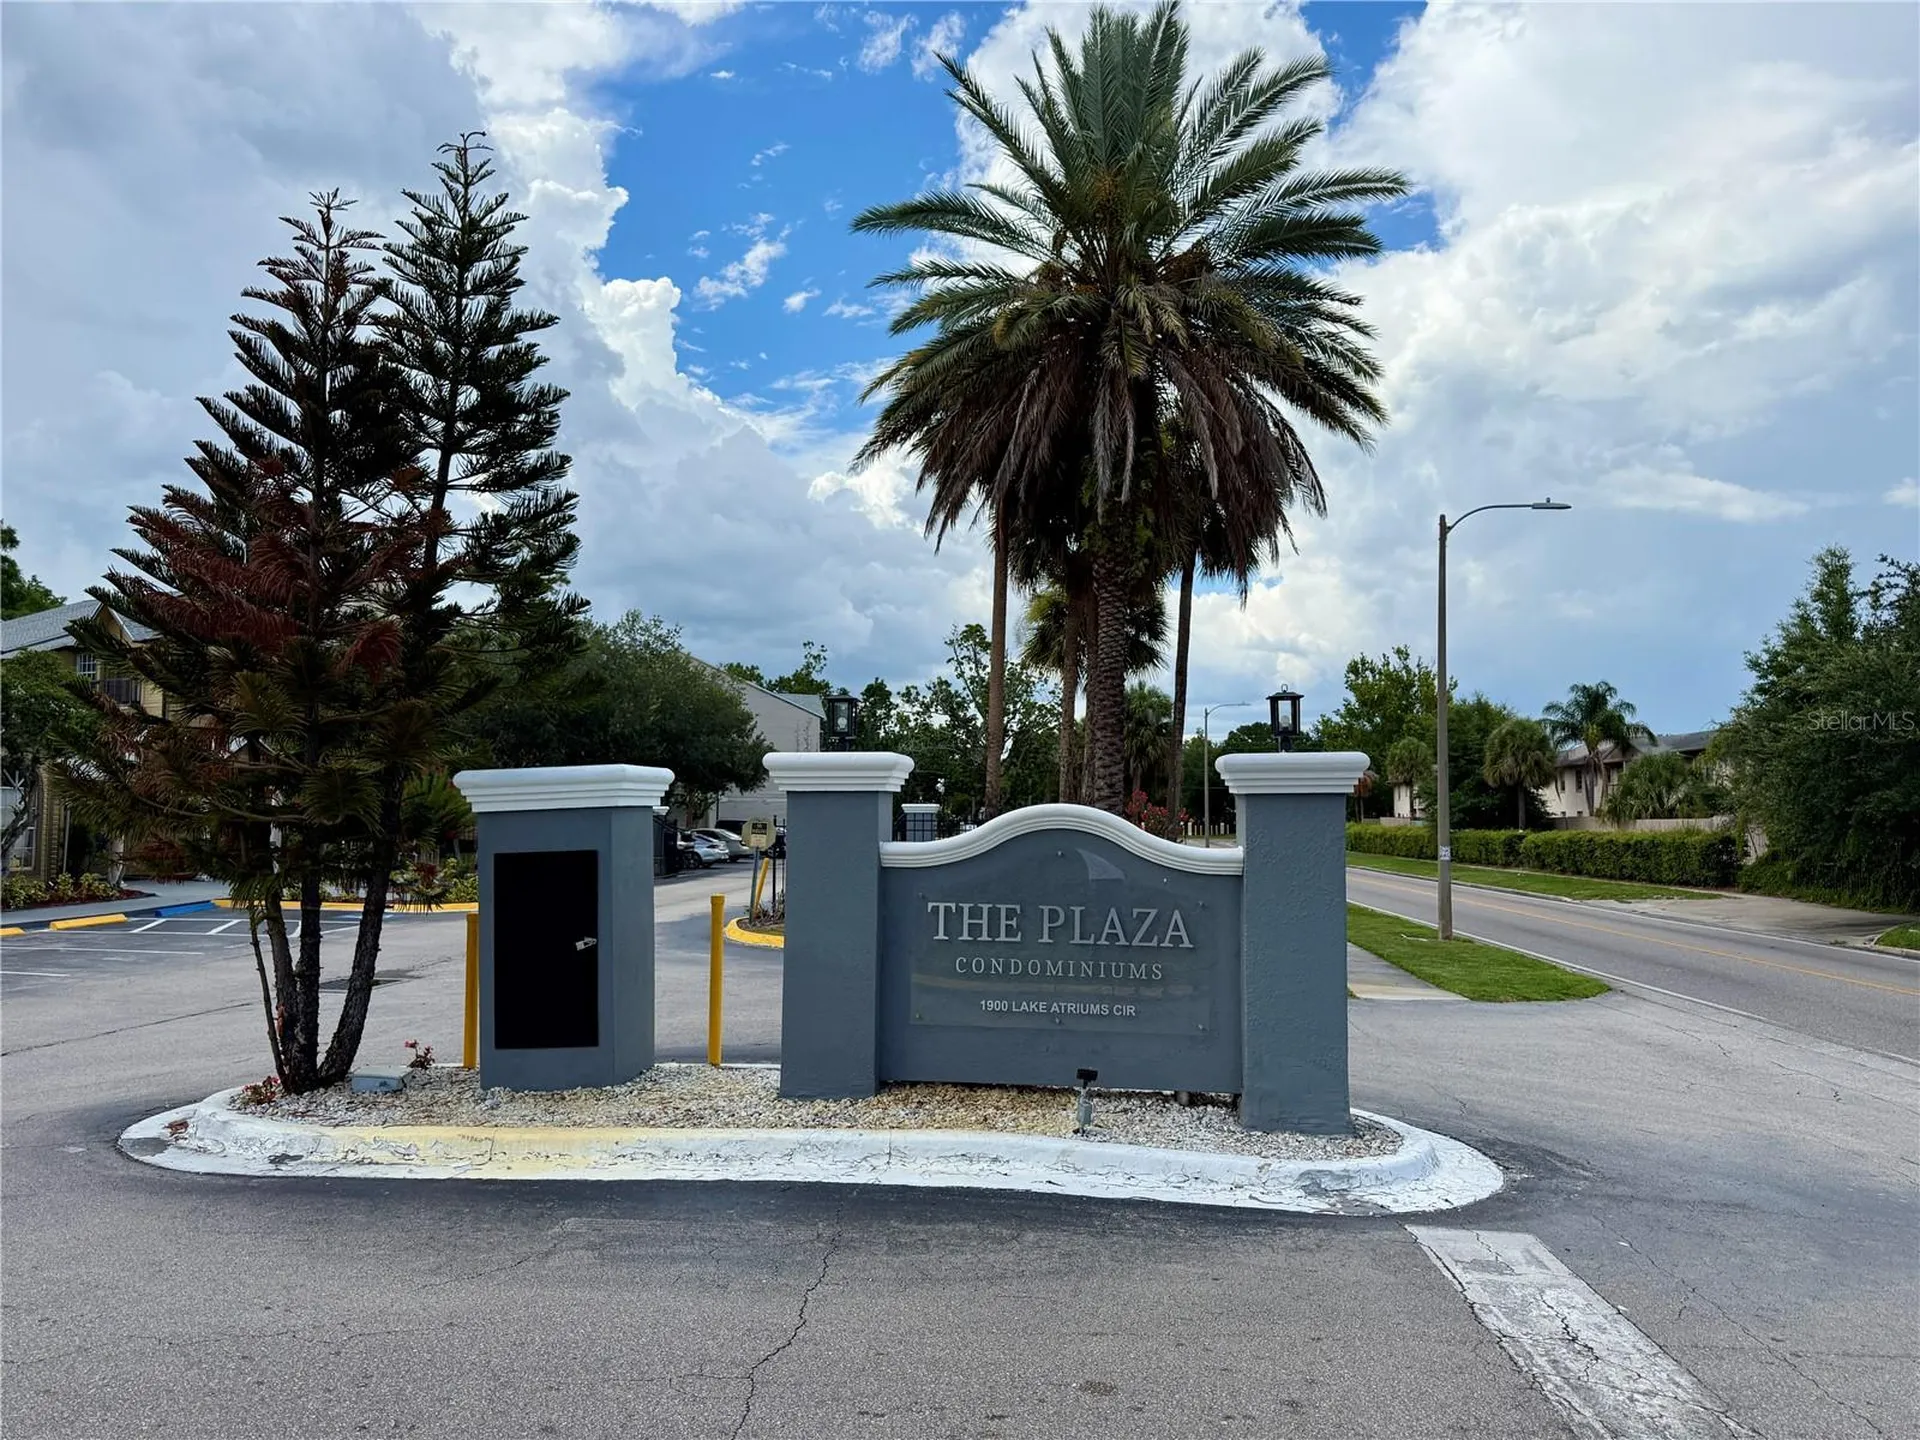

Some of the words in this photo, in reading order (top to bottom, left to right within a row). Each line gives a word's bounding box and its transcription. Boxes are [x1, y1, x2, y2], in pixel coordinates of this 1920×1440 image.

[927, 902, 1022, 942] THE
[1038, 905, 1194, 948] PLAZA
[955, 957, 1163, 980] CONDOMINIUMS
[980, 1000, 1008, 1012] 1900
[1012, 1001, 1047, 1013] LAKE
[1050, 1003, 1109, 1015] ATRIUMS
[1113, 1004, 1136, 1016] CIR
